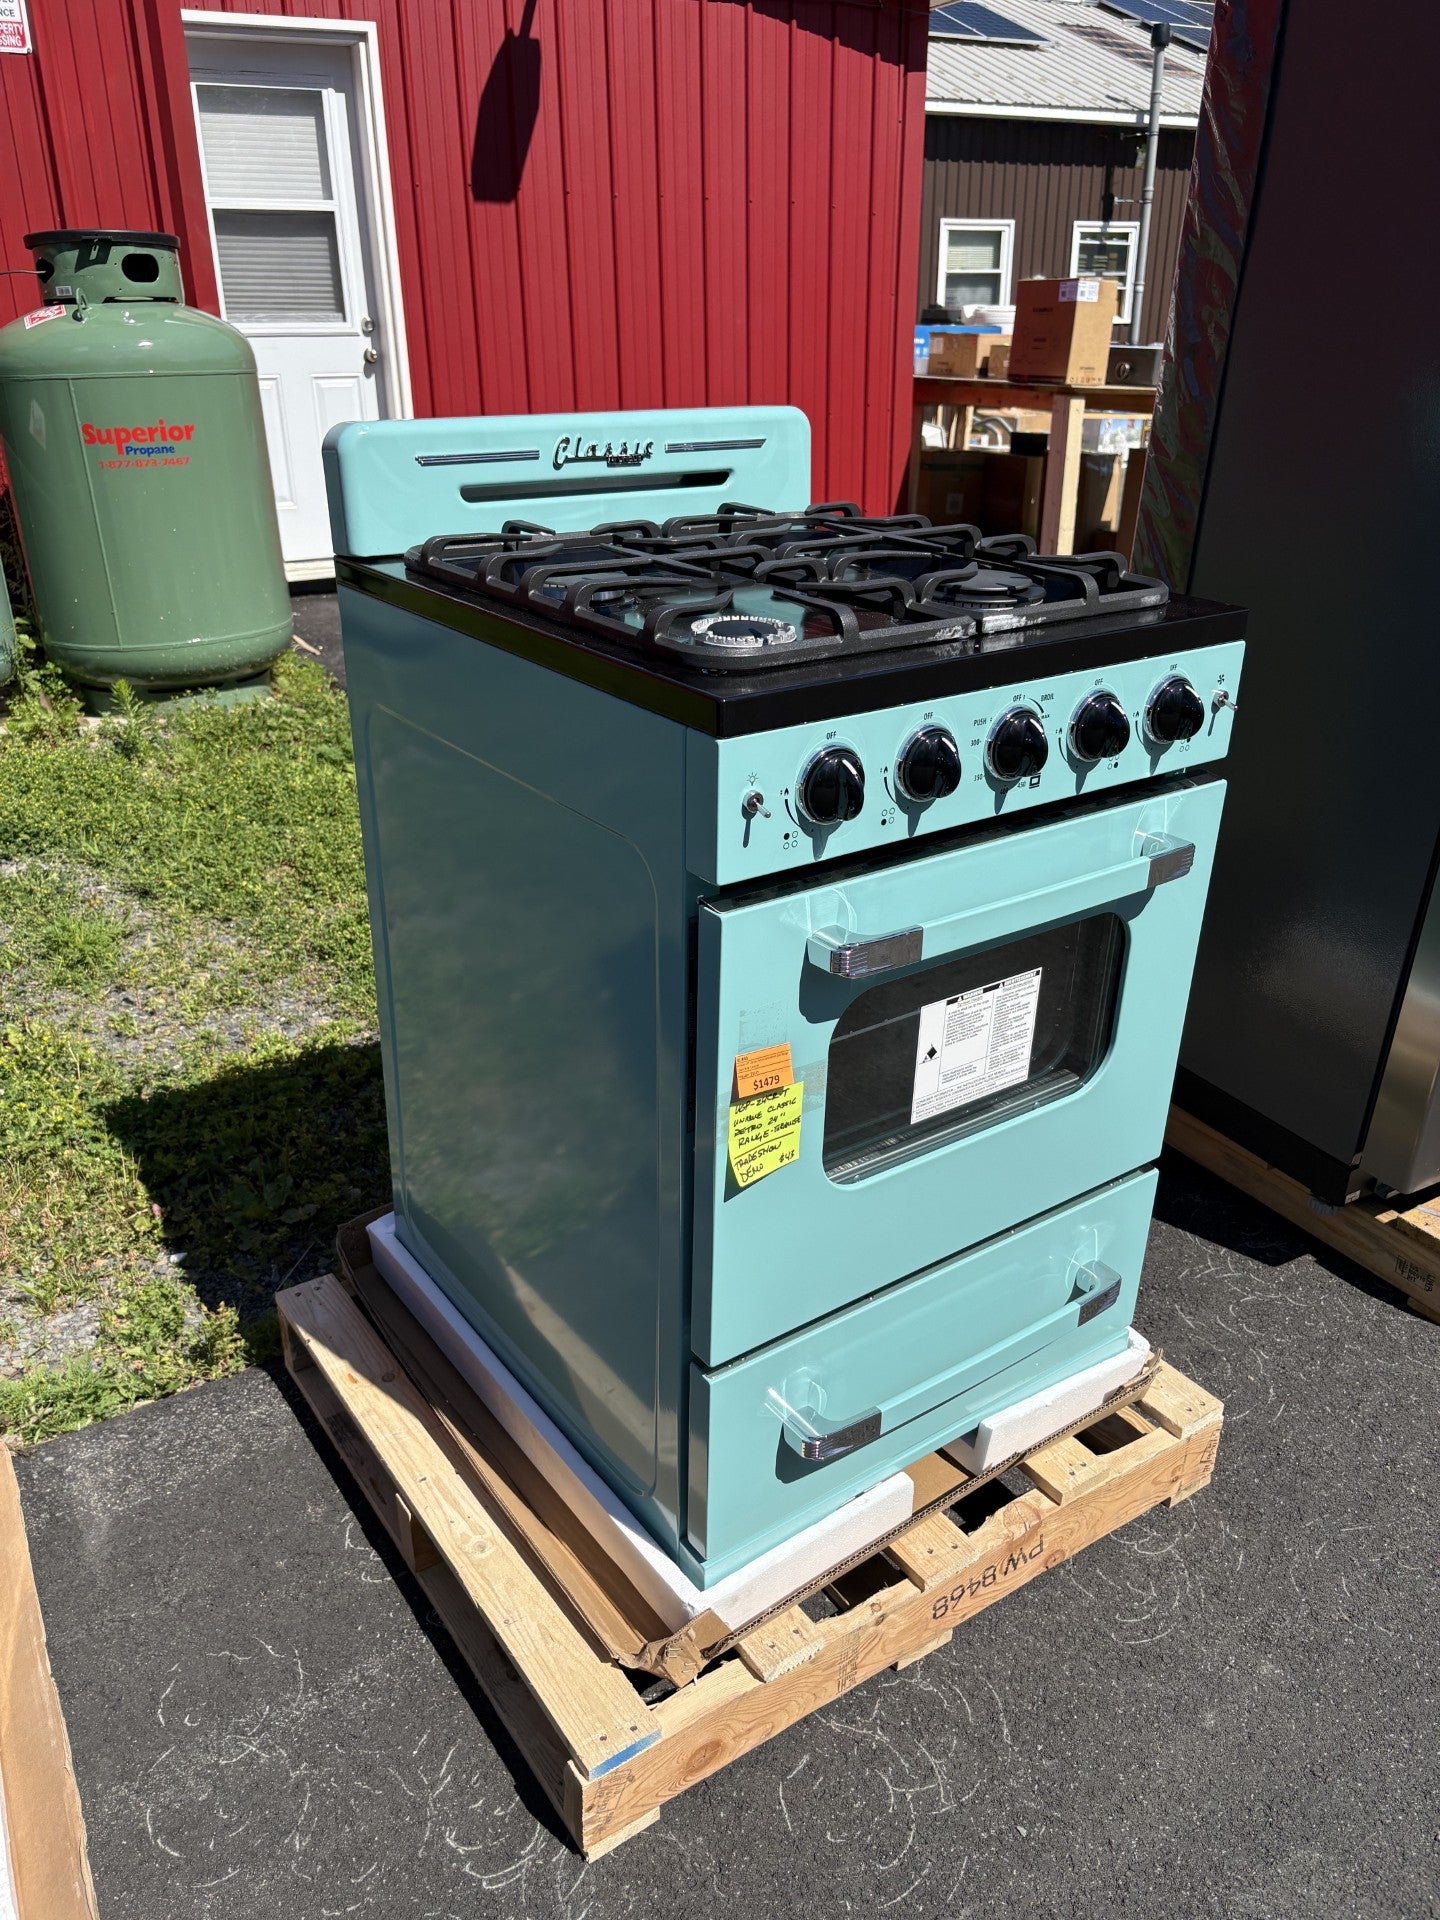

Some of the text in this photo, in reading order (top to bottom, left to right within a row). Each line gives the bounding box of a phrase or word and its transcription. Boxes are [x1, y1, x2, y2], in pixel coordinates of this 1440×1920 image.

[81, 418, 195, 456] Superior
[125, 446, 176, 457] Propane
[553, 434, 654, 471] Classic
[98, 456, 190, 470] 1-877-873-7467
[1169, 664, 1178, 672] OFF
[1094, 677, 1104, 686] OFF
[1012, 693, 1023, 702] OFF
[923, 711, 934, 721] OFF
[973, 717, 987, 727] PUSH
[826, 731, 837, 740] OFF
[753, 1074, 780, 1092] $1479
[767, 1096, 797, 1114] CLASSIC
[733, 1123, 763, 1138] RETRO
[739, 1163, 764, 1183] DEMO
[932, 1533, 1044, 1620] PW 8468
